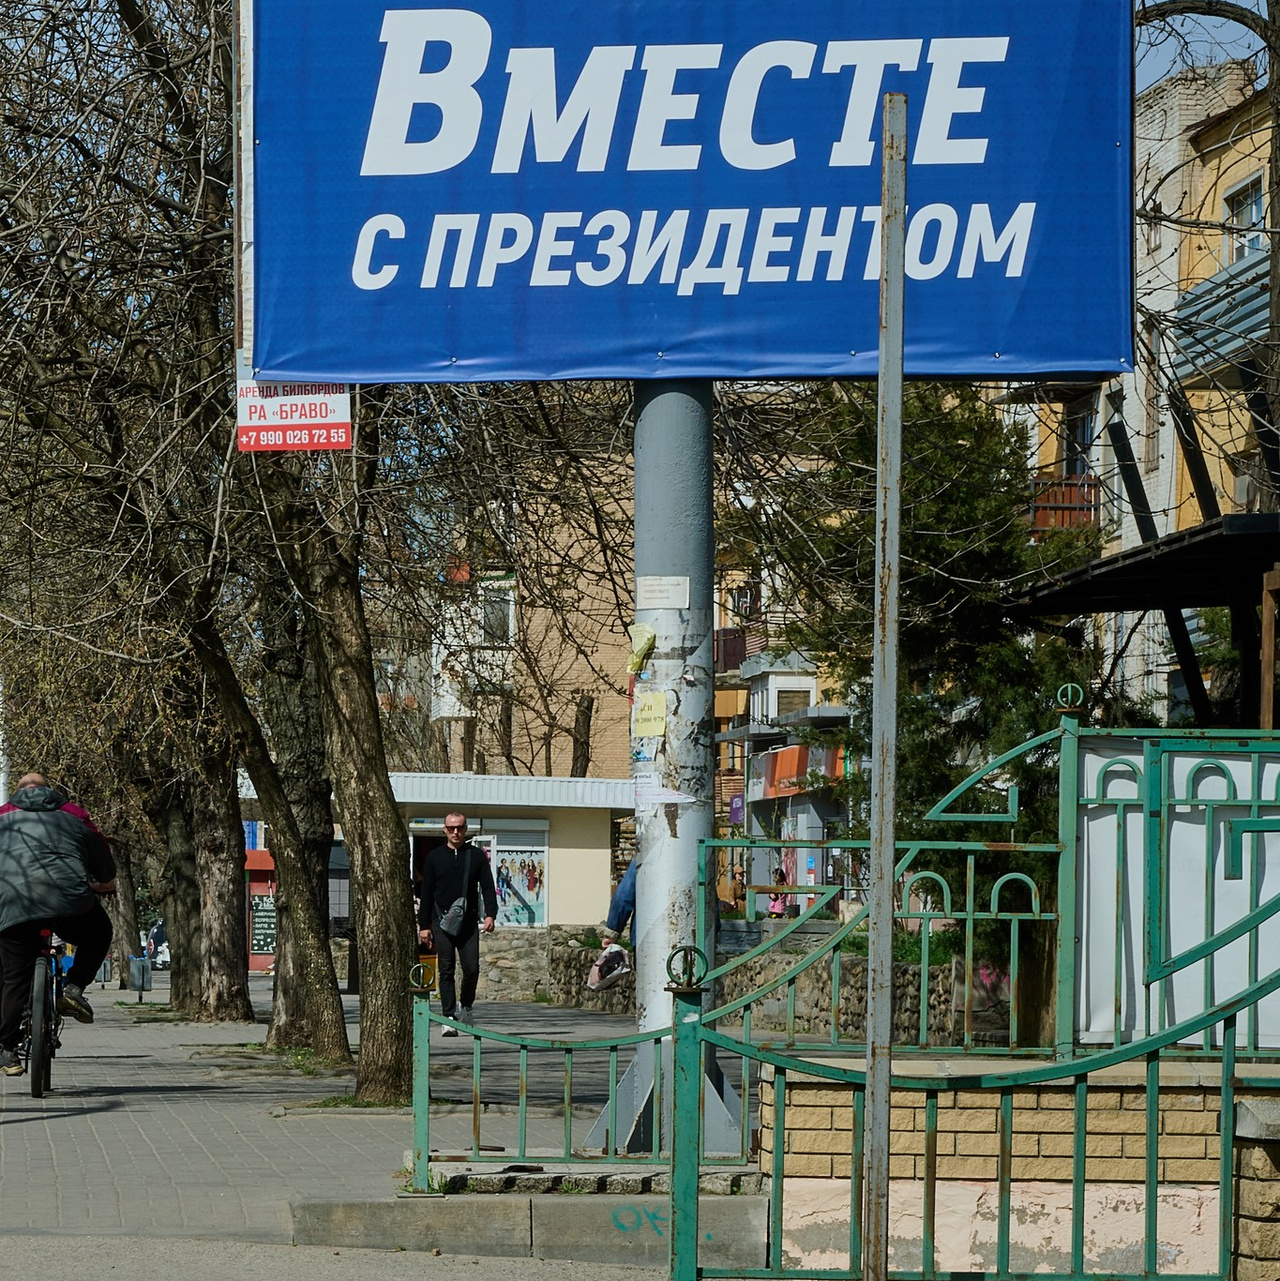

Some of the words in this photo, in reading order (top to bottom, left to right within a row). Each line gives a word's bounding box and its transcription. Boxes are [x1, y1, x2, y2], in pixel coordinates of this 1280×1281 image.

[239, 385, 279, 398] АРЕНДА
[282, 383, 345, 397] БИЛБОРДОВ
[248, 404, 267, 420] РА
[272, 402, 335, 420] «БРАВО»
[240, 432, 257, 445] +7
[260, 431, 283, 445] 990
[286, 430, 309, 444] 026
[312, 429, 327, 443] 72
[330, 429, 346, 442] 55
